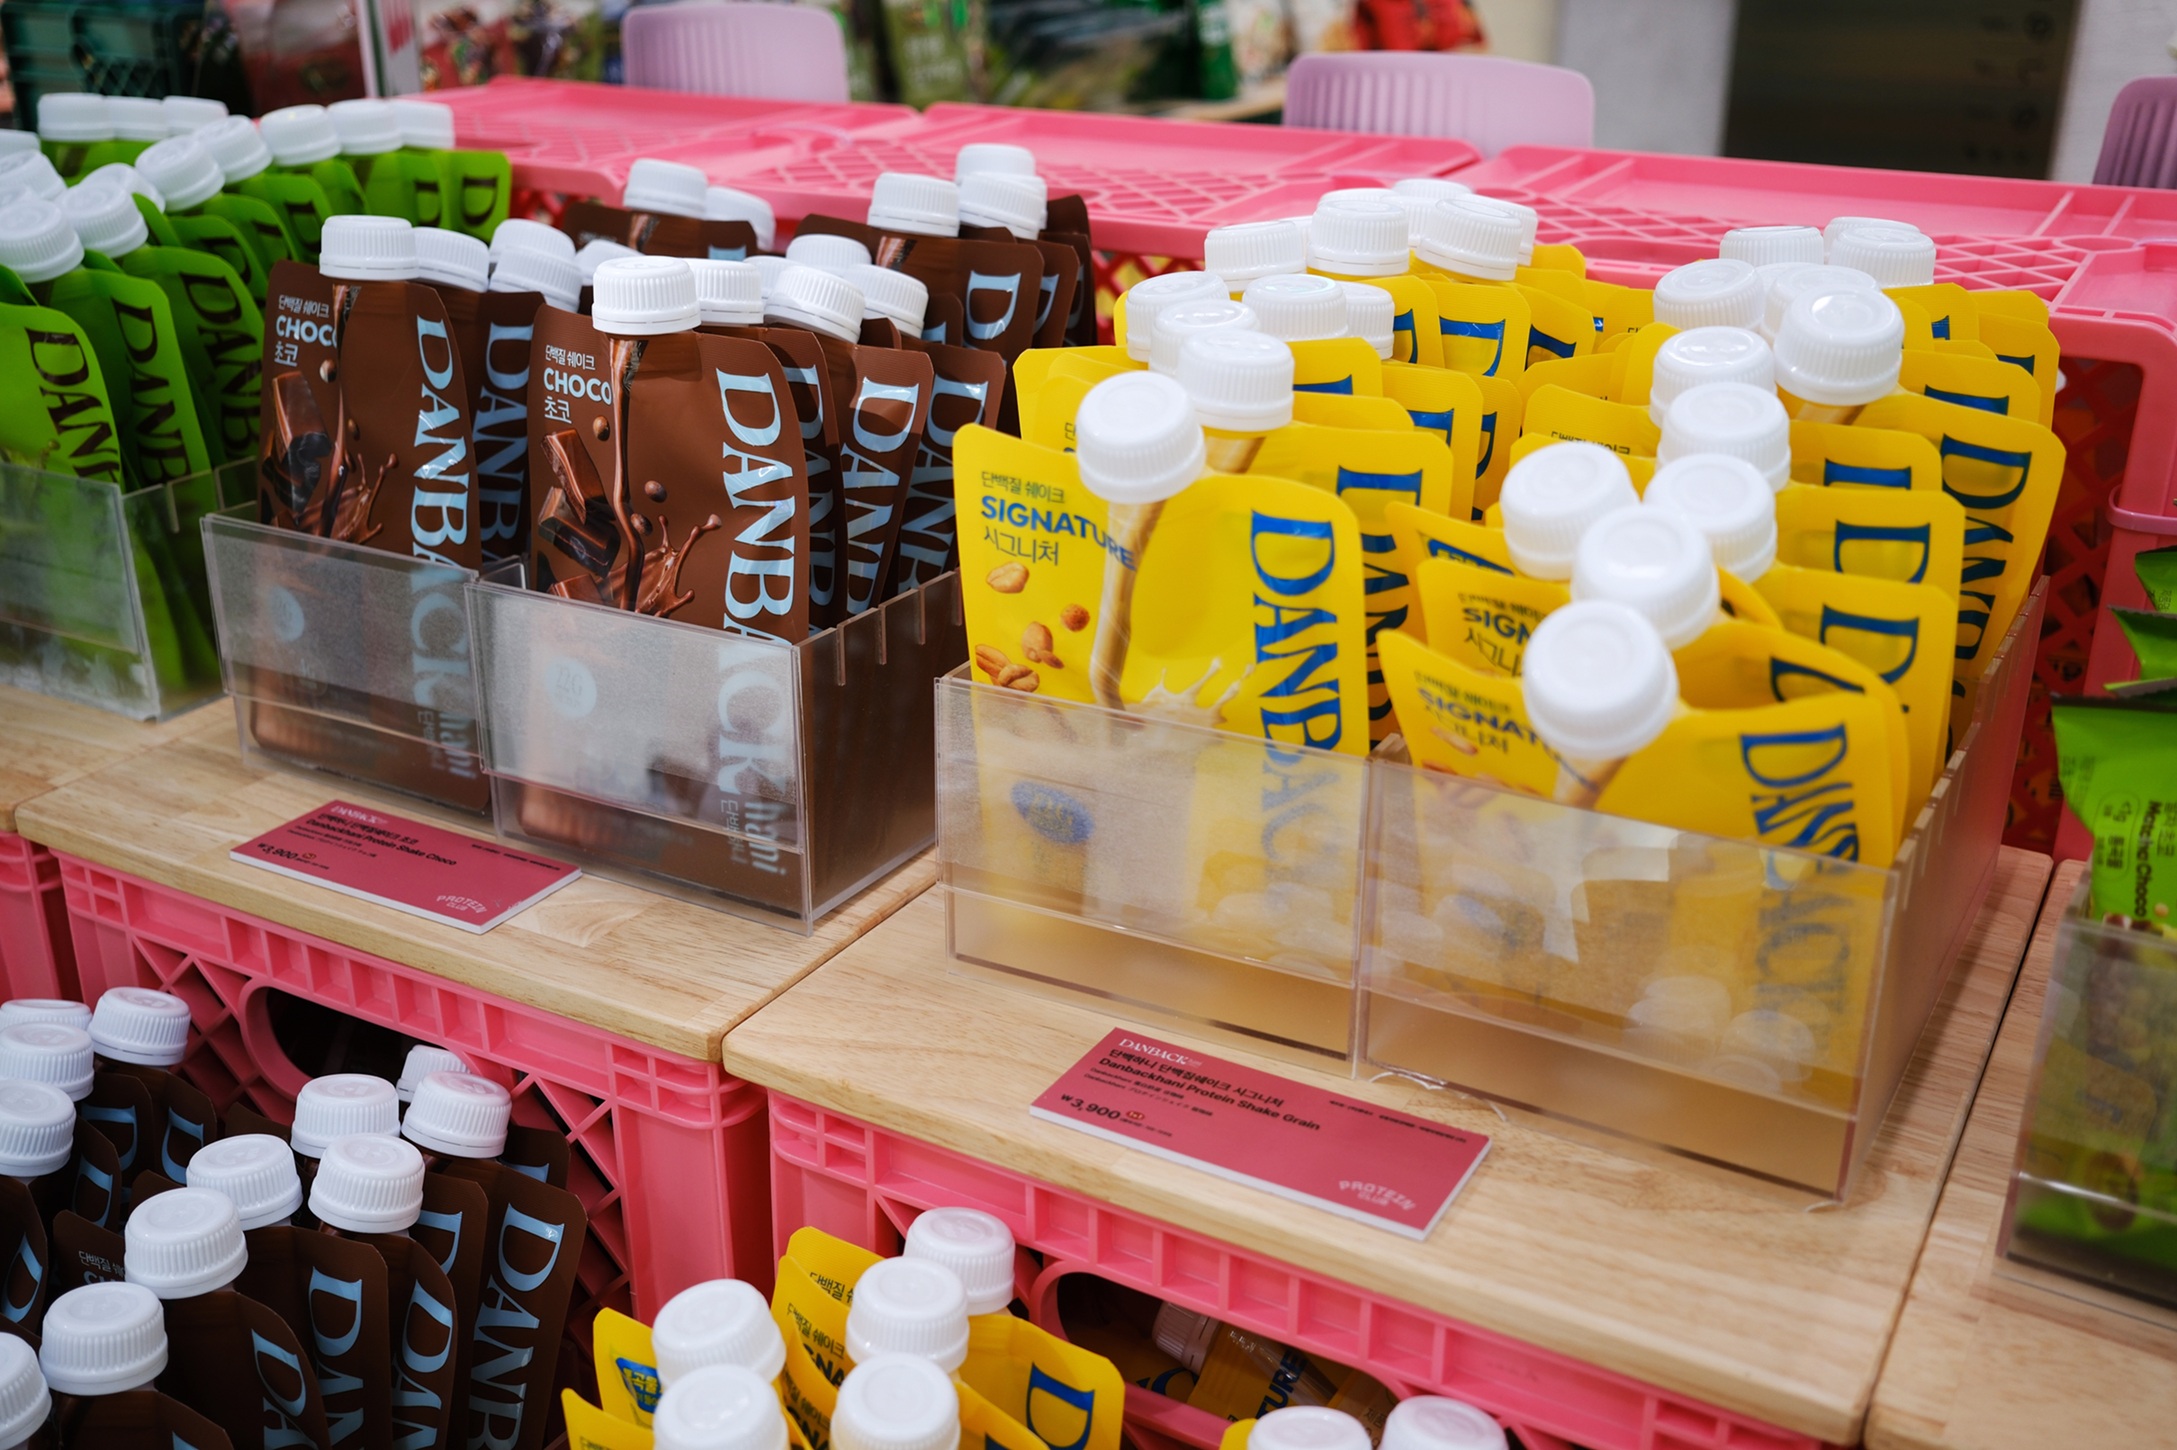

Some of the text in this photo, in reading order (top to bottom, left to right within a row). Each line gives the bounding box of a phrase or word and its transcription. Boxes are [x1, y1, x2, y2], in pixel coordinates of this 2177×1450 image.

[274, 341, 299, 367] 초코
[545, 344, 596, 371] 단백질 쉐이크
[544, 395, 573, 424] 초코
[981, 471, 1065, 504] 단백질 쉐이크
[983, 526, 1060, 567] 시그니처
[397, 844, 426, 858] Shake
[426, 853, 457, 866] Choco
[437, 895, 487, 914] PROTEIN
[2135, 863, 2153, 917] Choco
[1119, 1038, 1189, 1065] DANBACK
[1109, 1048, 1158, 1069] 단백하니
[1234, 1087, 1285, 1108] 시그니처
[1099, 1057, 1186, 1089] Danbackhani
[1186, 1083, 1236, 1106] Protein
[1237, 1100, 1280, 1119] Shake
[1282, 1113, 1321, 1132] Grain
[1338, 1180, 1417, 1211] PROTEIN
